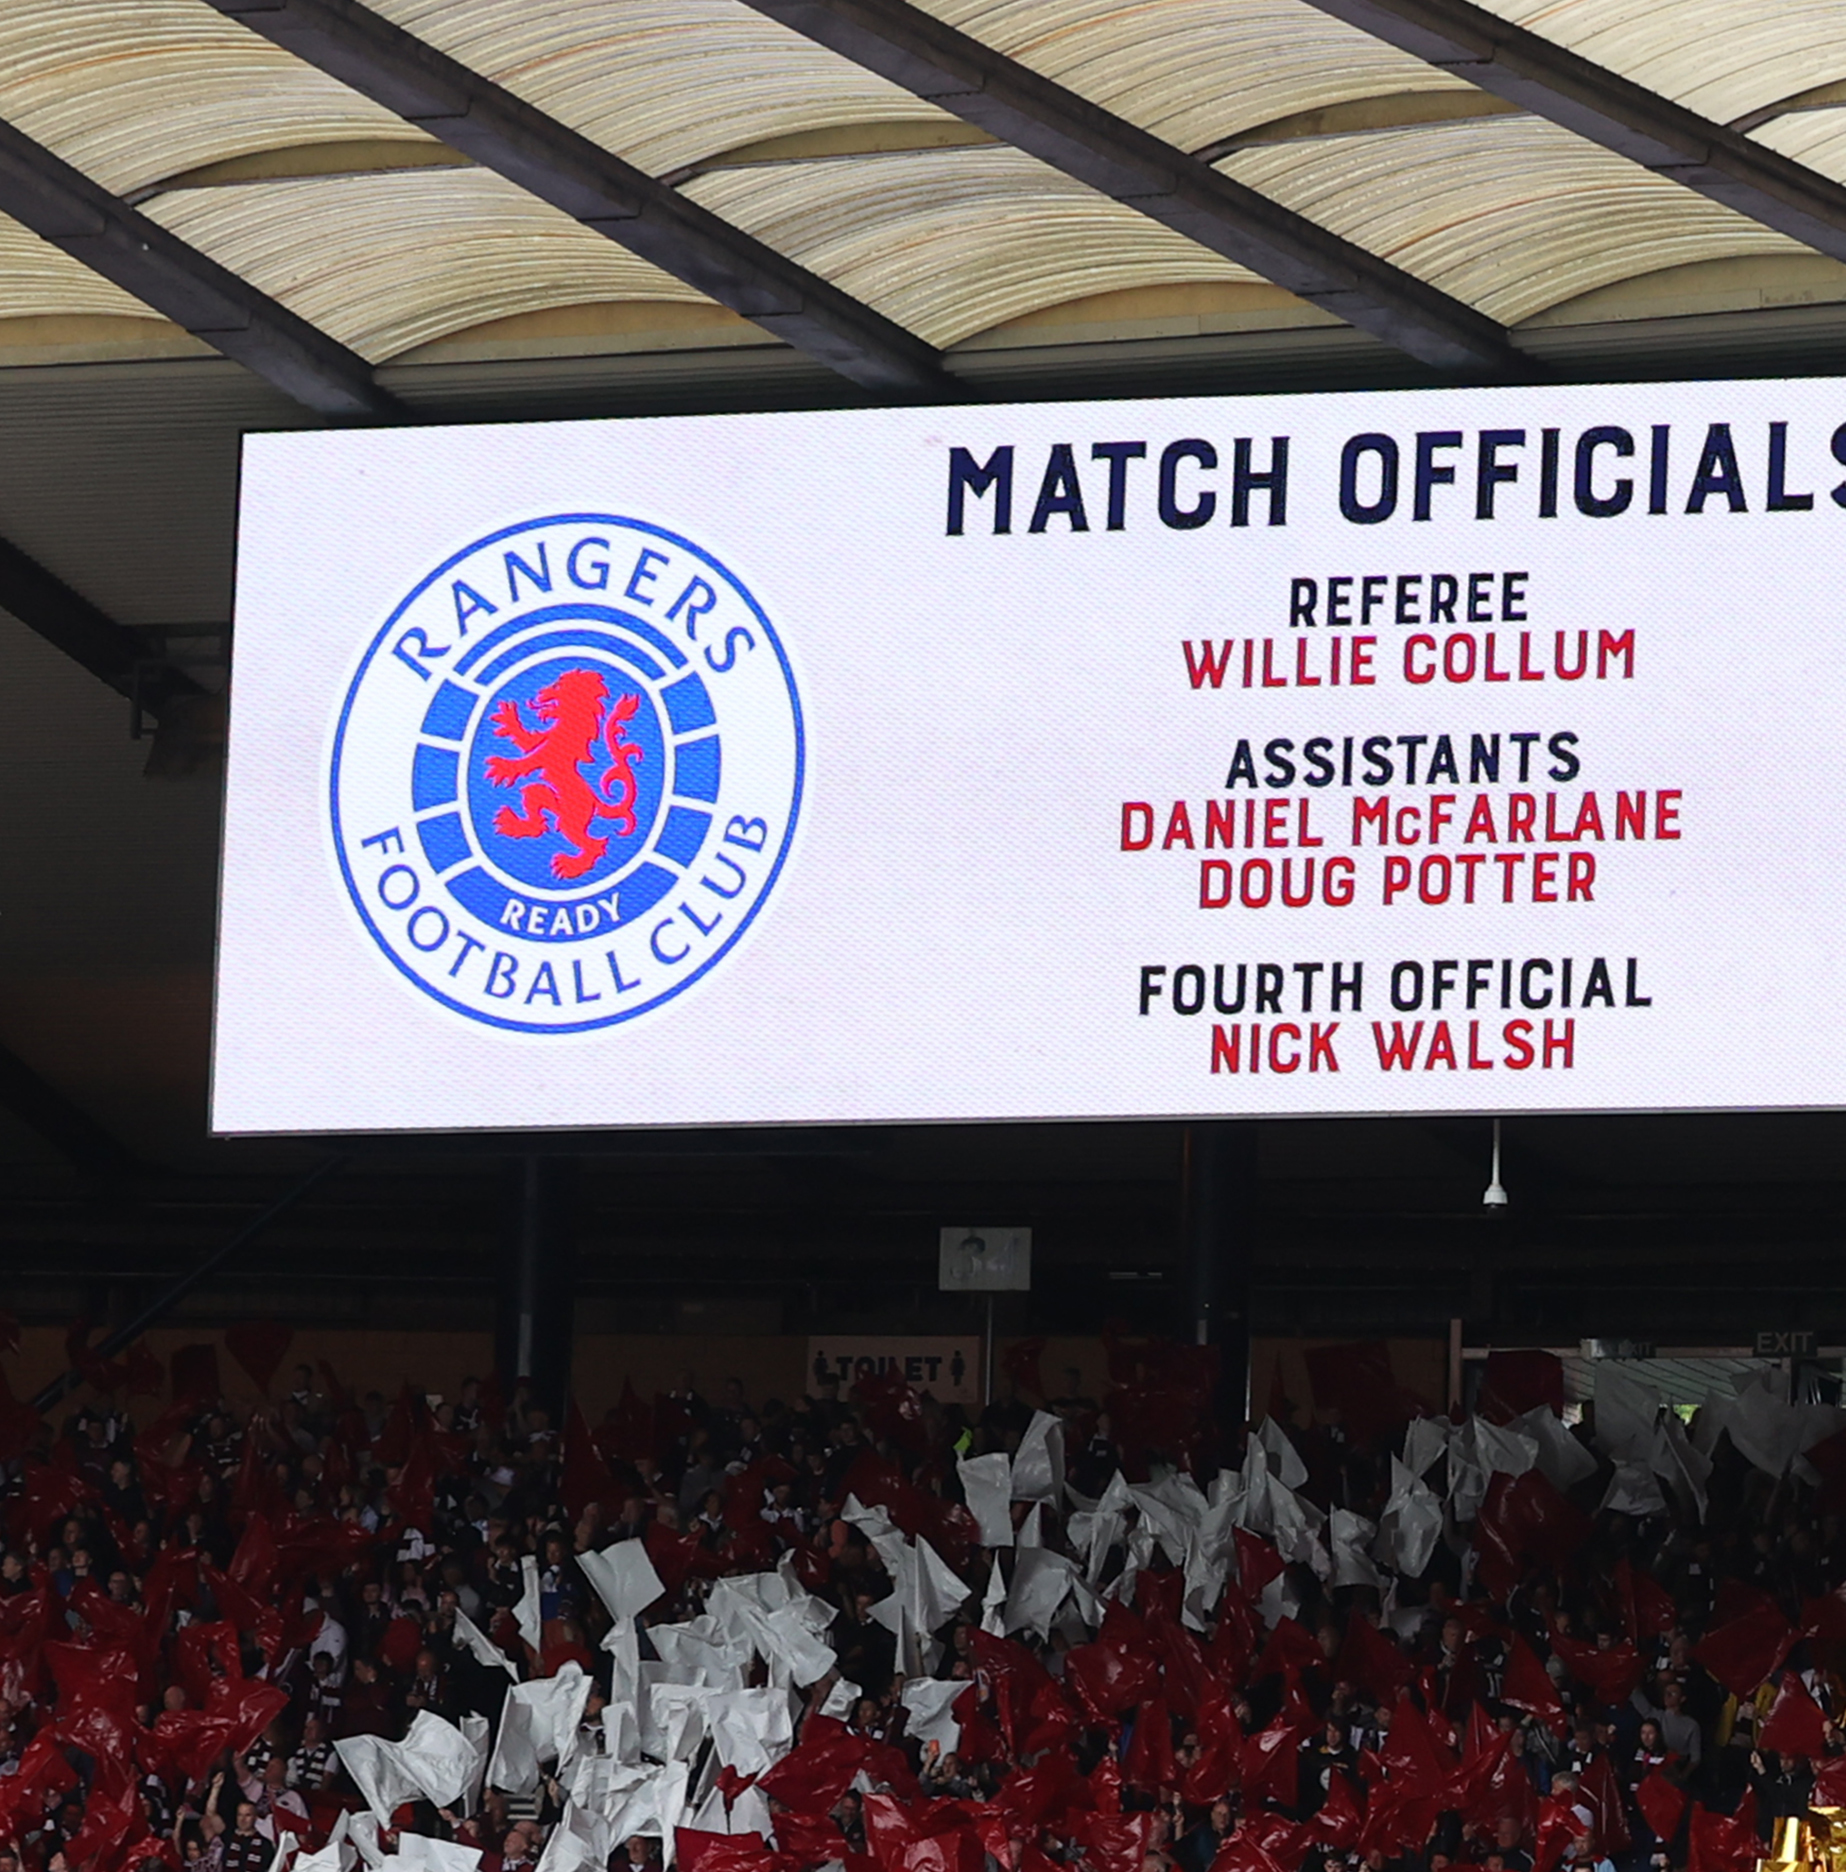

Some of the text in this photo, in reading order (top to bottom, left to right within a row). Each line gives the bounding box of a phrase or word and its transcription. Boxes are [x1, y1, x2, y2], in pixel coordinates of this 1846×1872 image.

[944, 434, 1291, 537] MATCH
[391, 536, 756, 682] RANGERS
[1288, 572, 1530, 628] REFEREE
[1181, 628, 1637, 690] WILLIE COLLUM
[1225, 731, 1582, 789] ASSISTANTS
[1120, 789, 1684, 852] DANIEL McFARLANE
[361, 813, 769, 1006] FOOTBALL CLUB
[1199, 851, 1598, 910] DOUG POTTER
[500, 892, 623, 937] READY
[1139, 957, 1653, 1016] FOURTH OFFICIAL
[1210, 1017, 1576, 1075] NICK WALSH
[836, 1356, 942, 1382] TOIET
[1756, 1332, 1814, 1353] EXIT
